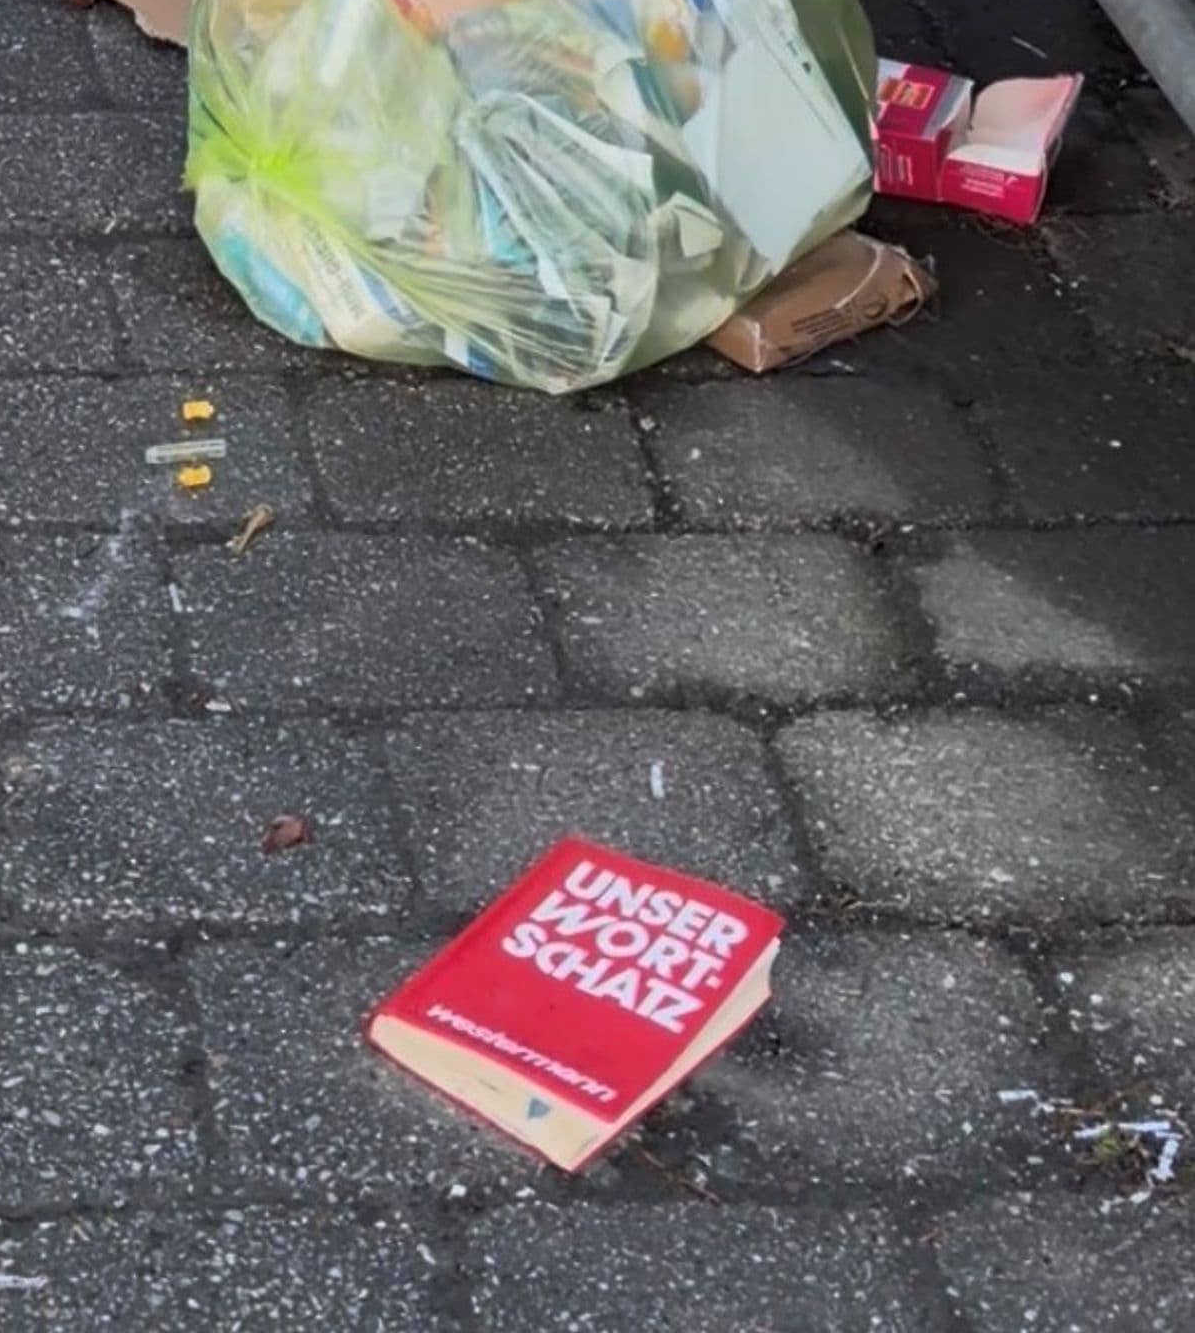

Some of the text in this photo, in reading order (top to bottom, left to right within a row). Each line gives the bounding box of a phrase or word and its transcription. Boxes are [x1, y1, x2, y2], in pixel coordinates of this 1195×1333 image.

[528, 889, 725, 990] WORT-
[563, 860, 749, 959] UNSER
[501, 922, 704, 1035] SCHATZ
[425, 1004, 619, 1102] westermann
